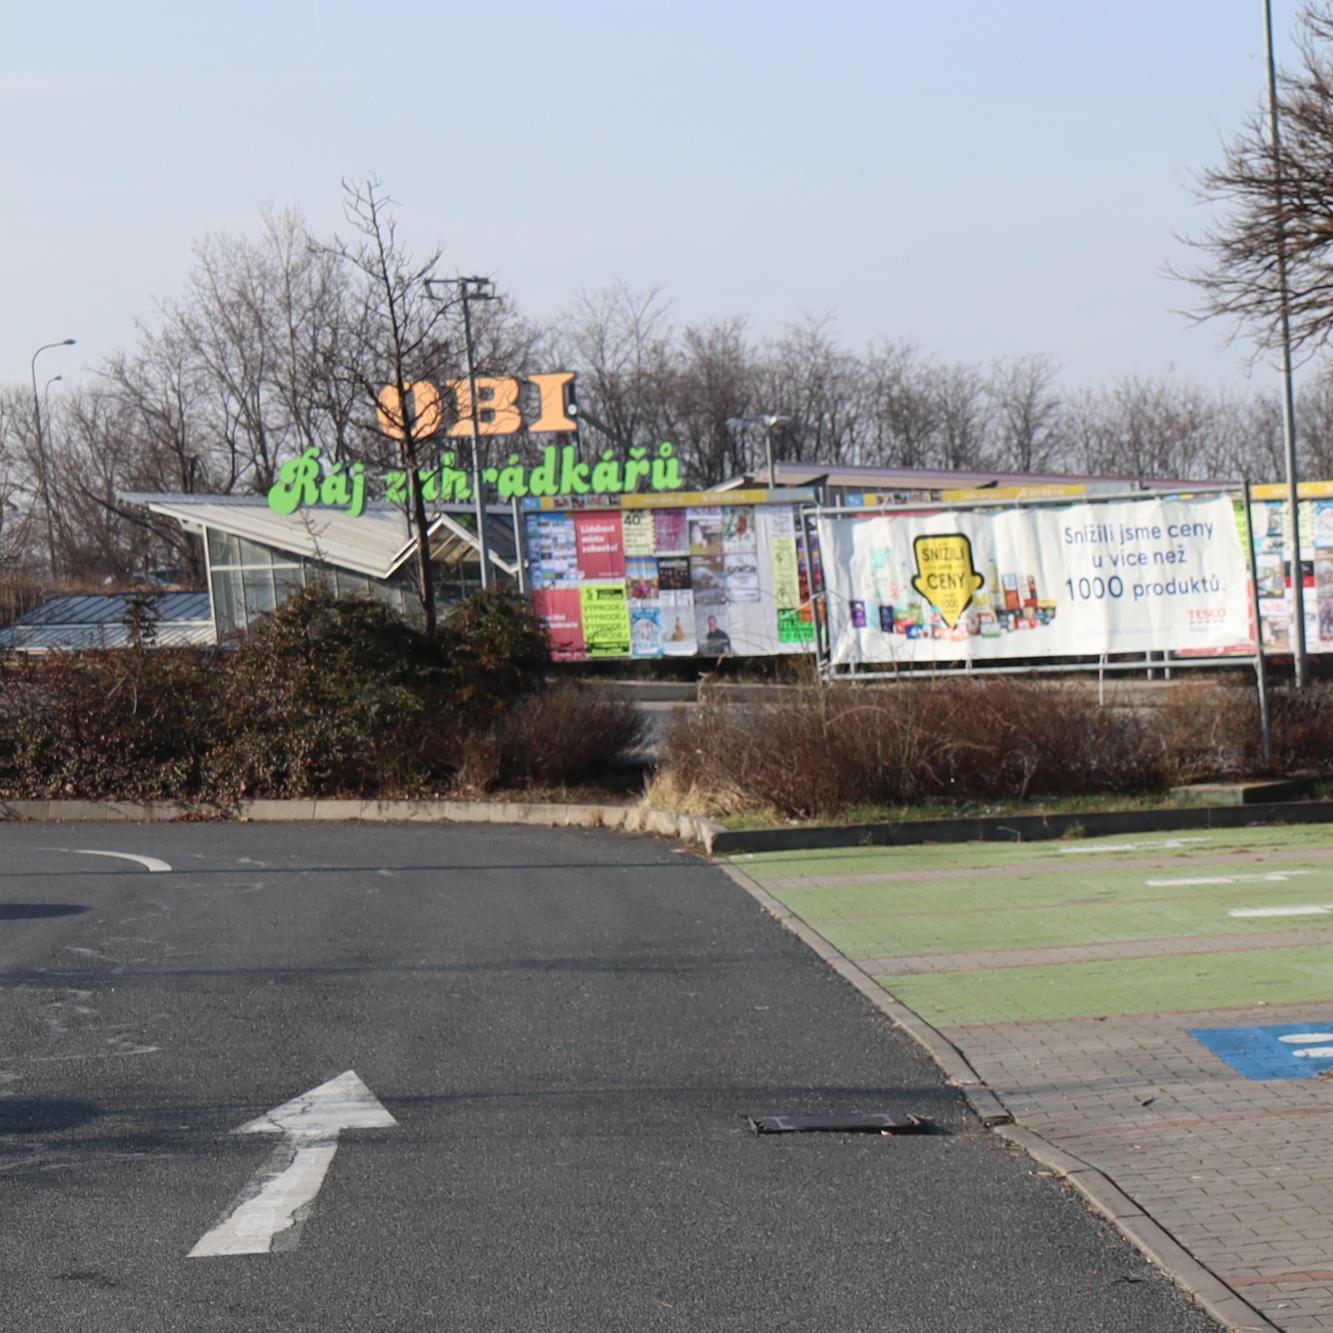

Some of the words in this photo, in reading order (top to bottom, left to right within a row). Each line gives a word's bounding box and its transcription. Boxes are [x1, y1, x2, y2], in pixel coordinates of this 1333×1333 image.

[376, 371, 578, 440] OBI
[267, 442, 366, 519] Ráj
[1065, 522, 1114, 545] Snížili
[1120, 523, 1162, 545] jsme
[1167, 520, 1214, 540] ceny
[921, 544, 965, 562] SNÍŽILI
[1092, 555, 1103, 568] u
[1108, 548, 1148, 568] více
[1153, 544, 1187, 564] než
[926, 573, 966, 590] CENY
[1065, 574, 1124, 601] 1000
[1187, 607, 1227, 620] TESCO
